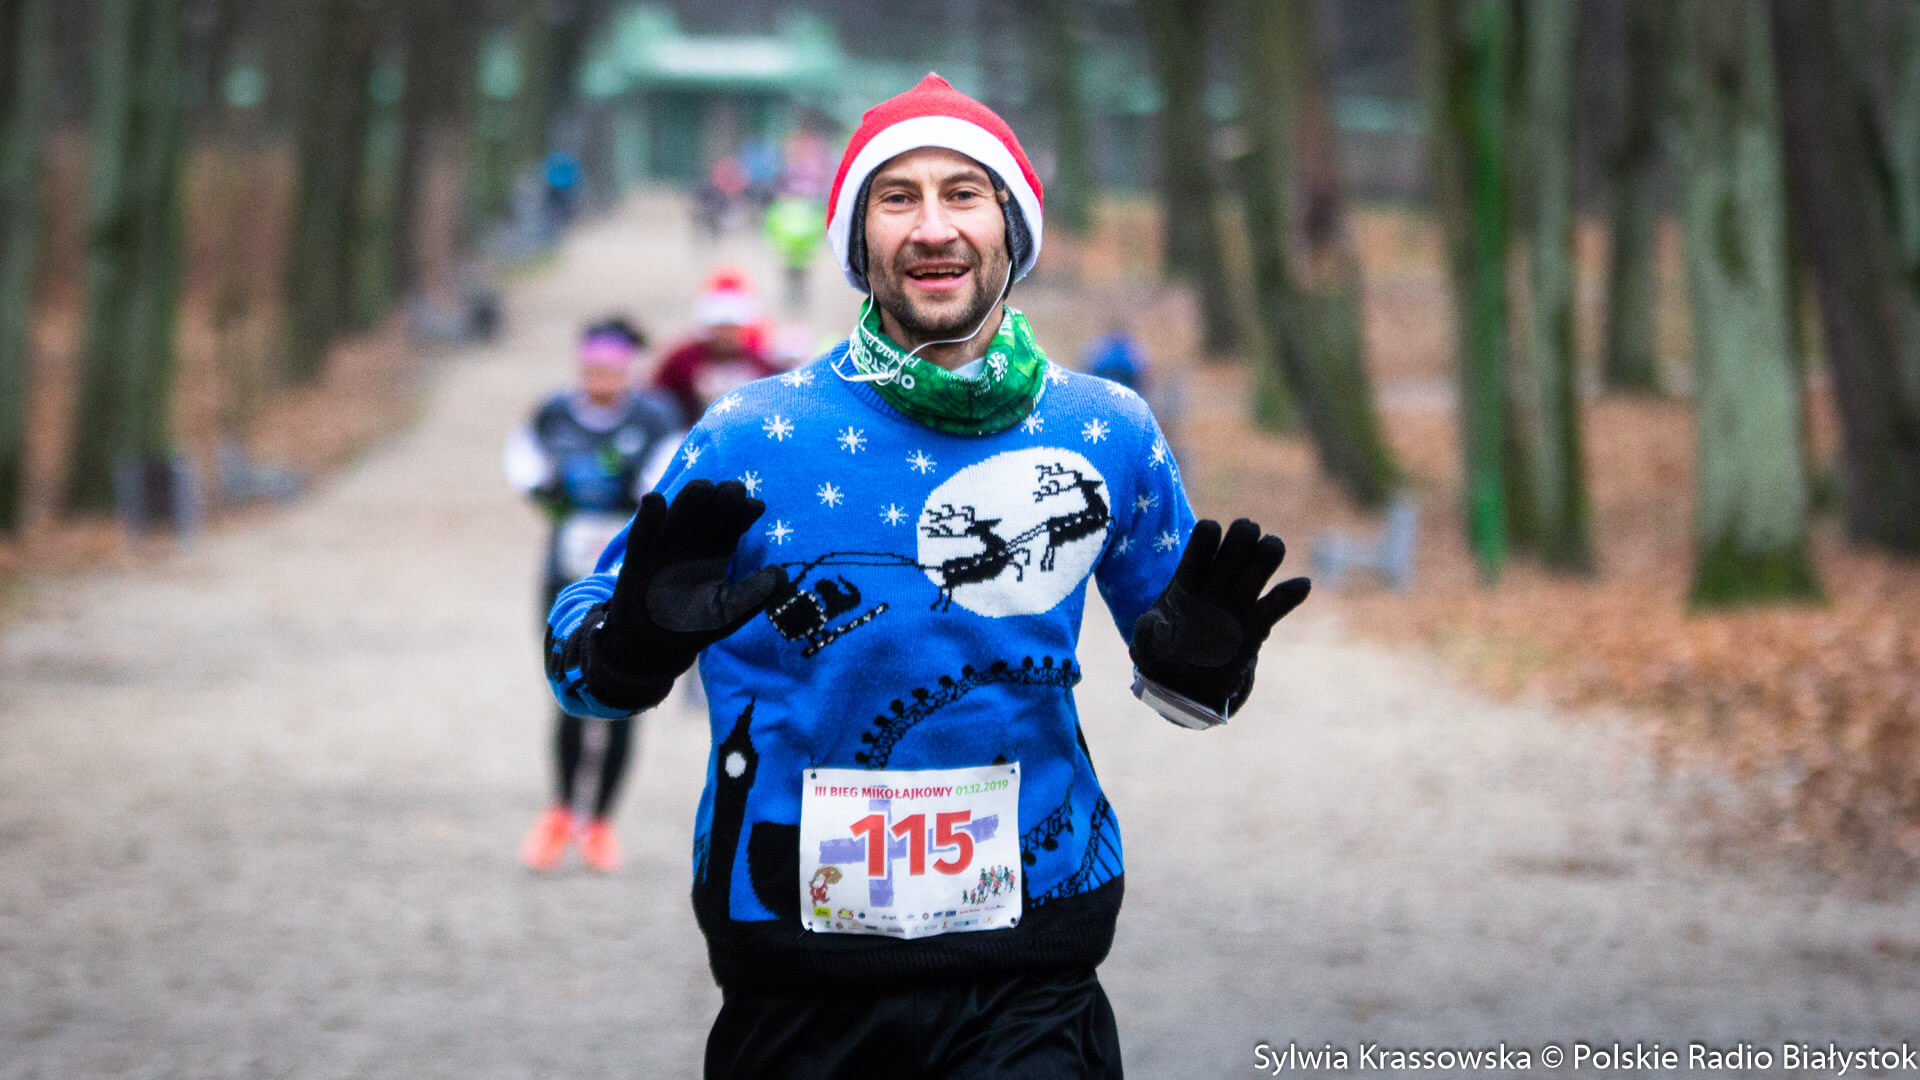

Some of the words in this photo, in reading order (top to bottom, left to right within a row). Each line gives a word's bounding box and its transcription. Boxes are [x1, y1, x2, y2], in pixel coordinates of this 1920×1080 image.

[814, 786, 826, 797] III
[830, 786, 858, 798] BIEG
[861, 786, 953, 800] MIKOŁAJKOWY
[955, 779, 1009, 796] 01.12.2019
[849, 810, 975, 877] 115
